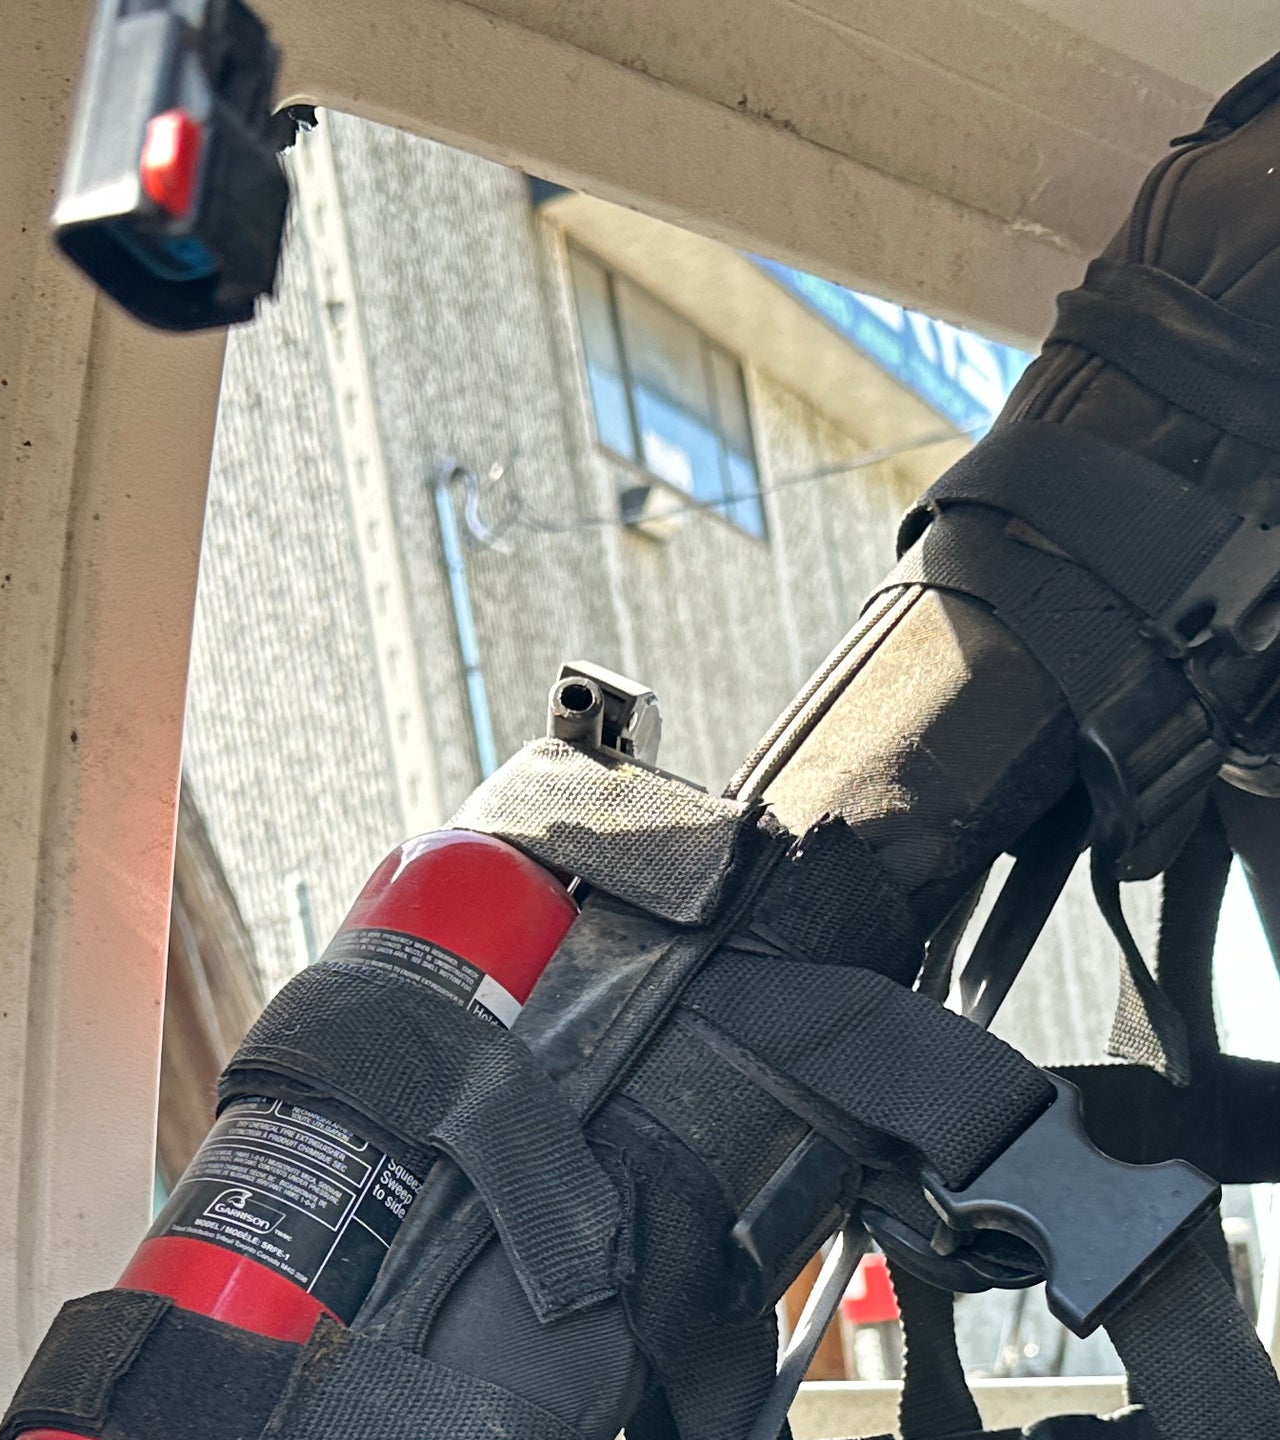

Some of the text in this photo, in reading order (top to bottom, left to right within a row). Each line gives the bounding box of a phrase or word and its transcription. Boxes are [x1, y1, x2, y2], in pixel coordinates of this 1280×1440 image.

[248, 1121, 279, 1132] CHEMICAL
[280, 1127, 296, 1137] FIRE
[295, 1132, 345, 1161] EXTINGUISHER
[268, 1133, 298, 1148] PRODUIT
[296, 1143, 332, 1164] CHIMIQUE
[331, 1160, 347, 1172] SEC
[371, 1183, 385, 1200] to
[379, 1169, 413, 1206] Sweep
[214, 1201, 270, 1229] GARRISON
[194, 1218, 220, 1229] MODEL
[224, 1225, 260, 1245] MODÈLE:
[260, 1240, 289, 1260] SRFE-1
[234, 1240, 256, 1254] Toronto
[256, 1250, 280, 1266] Canada
